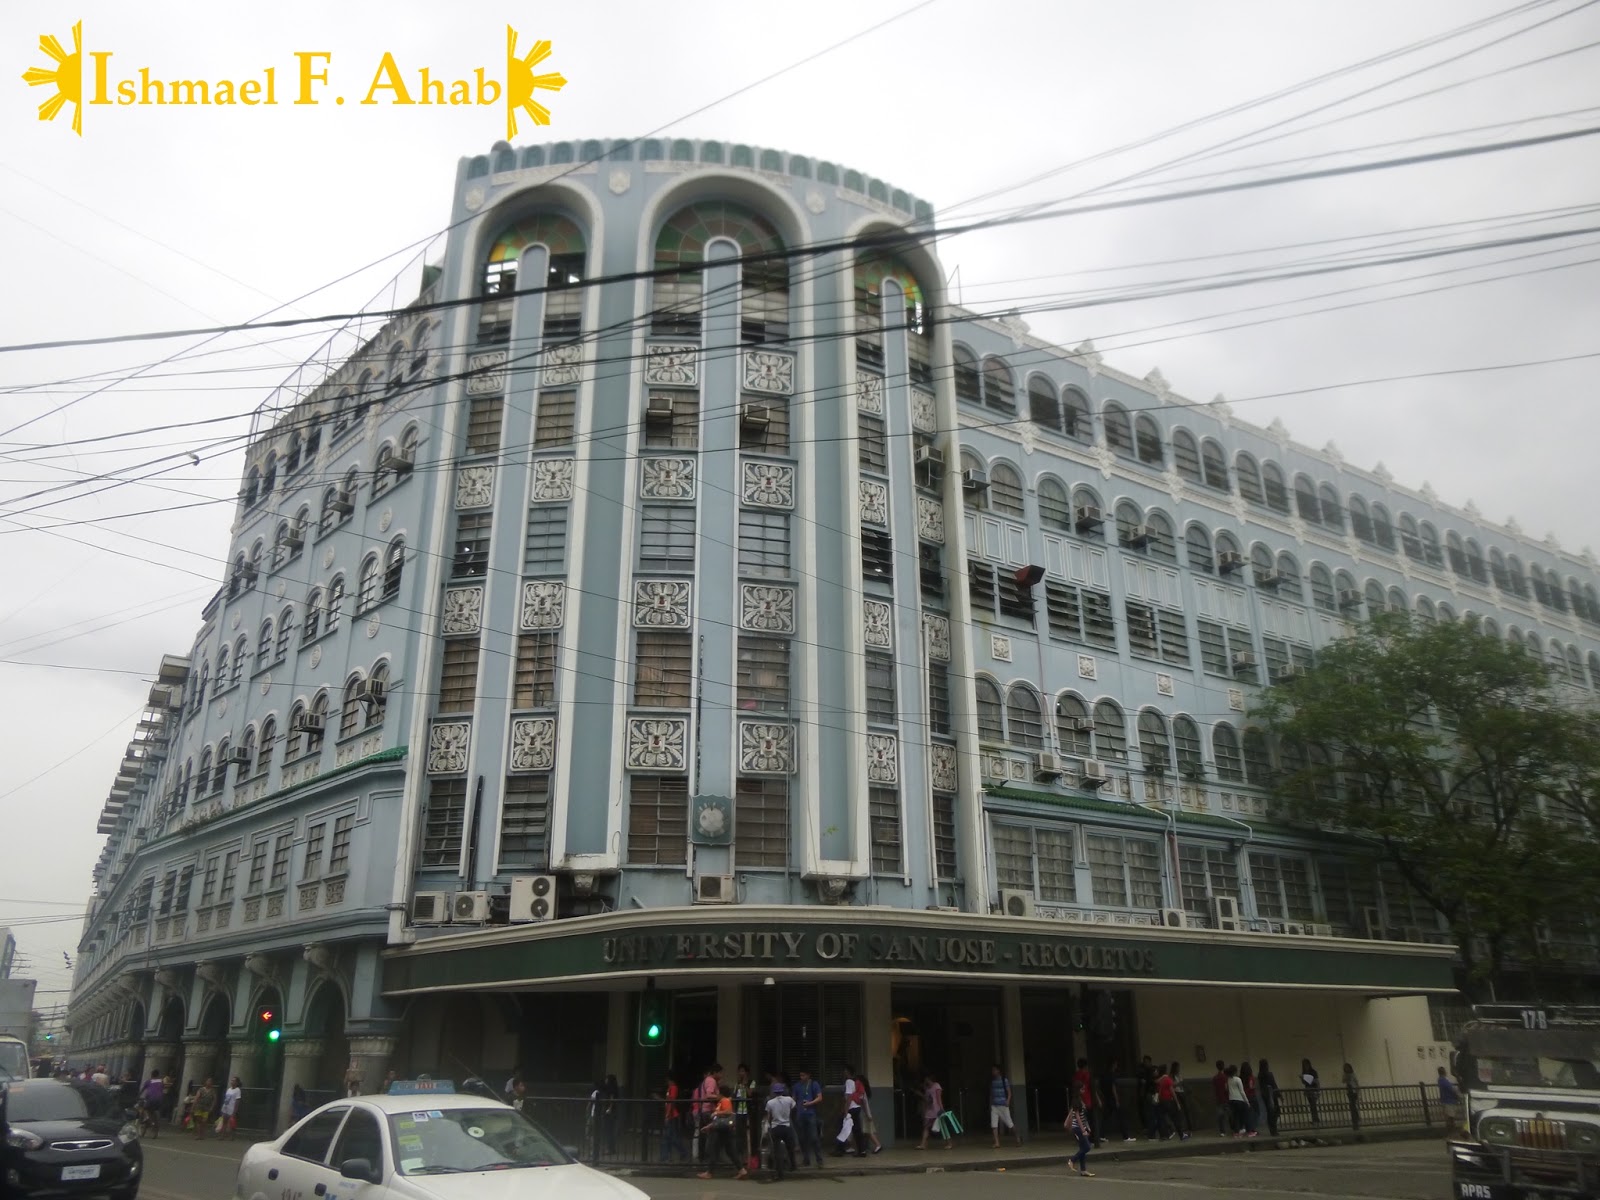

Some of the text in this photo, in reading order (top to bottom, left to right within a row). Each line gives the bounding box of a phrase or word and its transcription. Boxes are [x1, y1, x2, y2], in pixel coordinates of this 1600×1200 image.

[603, 931, 806, 962] UNIVERSITY
[816, 932, 860, 959] OF
[869, 934, 928, 961] SAN
[935, 938, 997, 965] JOSE
[1019, 942, 1155, 971] RECOLETOS
